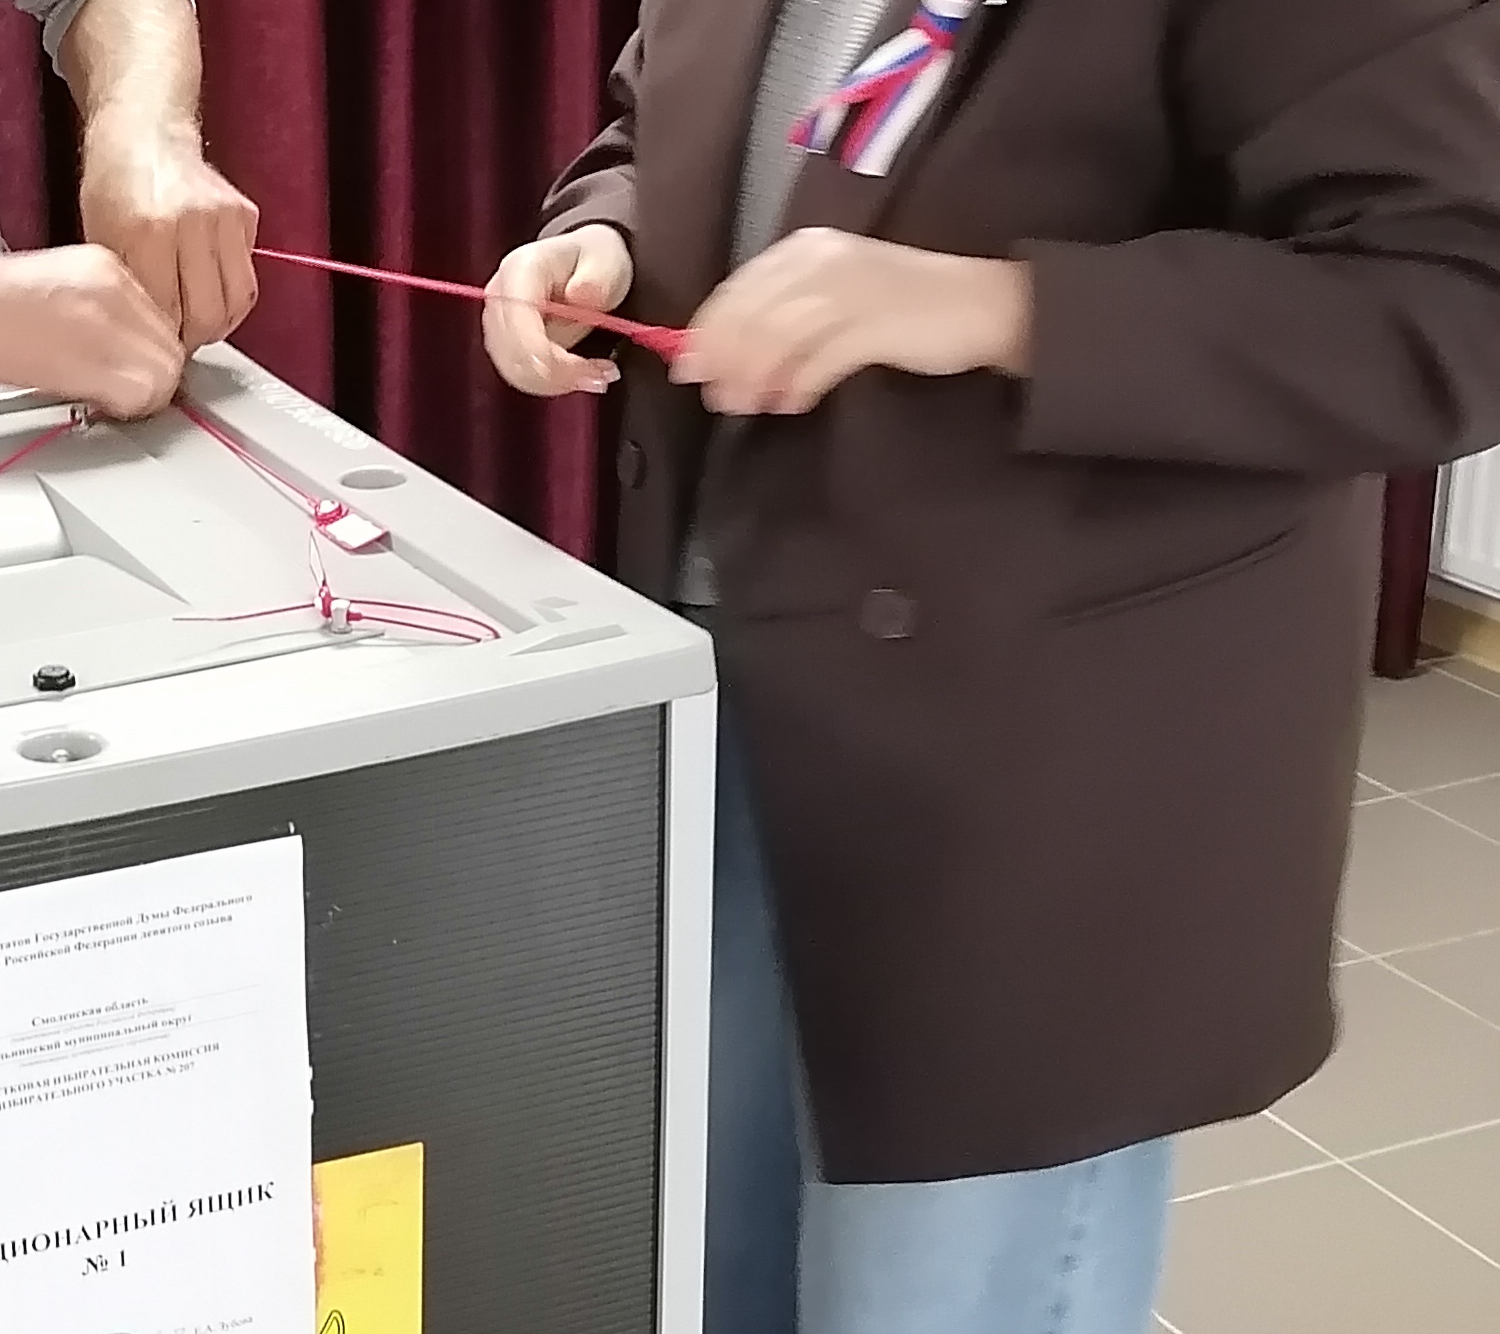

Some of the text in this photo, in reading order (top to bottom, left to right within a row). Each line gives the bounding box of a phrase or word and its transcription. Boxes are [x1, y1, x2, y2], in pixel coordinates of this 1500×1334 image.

[35, 916, 133, 944] Государственной
[136, 910, 169, 926] Думы
[172, 894, 253, 916] Федерального
[4, 944, 71, 967] Российской
[74, 931, 138, 953] Федерации
[140, 923, 191, 940] девятого
[193, 913, 233, 929] созыва
[31, 1005, 102, 1027] Смоленская
[104, 995, 149, 1012] область
[64, 1020, 159, 1049] муниципальный
[161, 1013, 193, 1030] округ
[53, 1057, 151, 1086] ИЗБИРАТЕЛЬНАЯ
[153, 1042, 220, 1064] КОМИССИЯ
[108, 1068, 162, 1091] УЧАСТКА
[164, 1065, 177, 1077] №
[179, 1061, 196, 1074] 207
[187, 1181, 275, 1220] ЯЩИК
[81, 1249, 128, 1277] № 1
